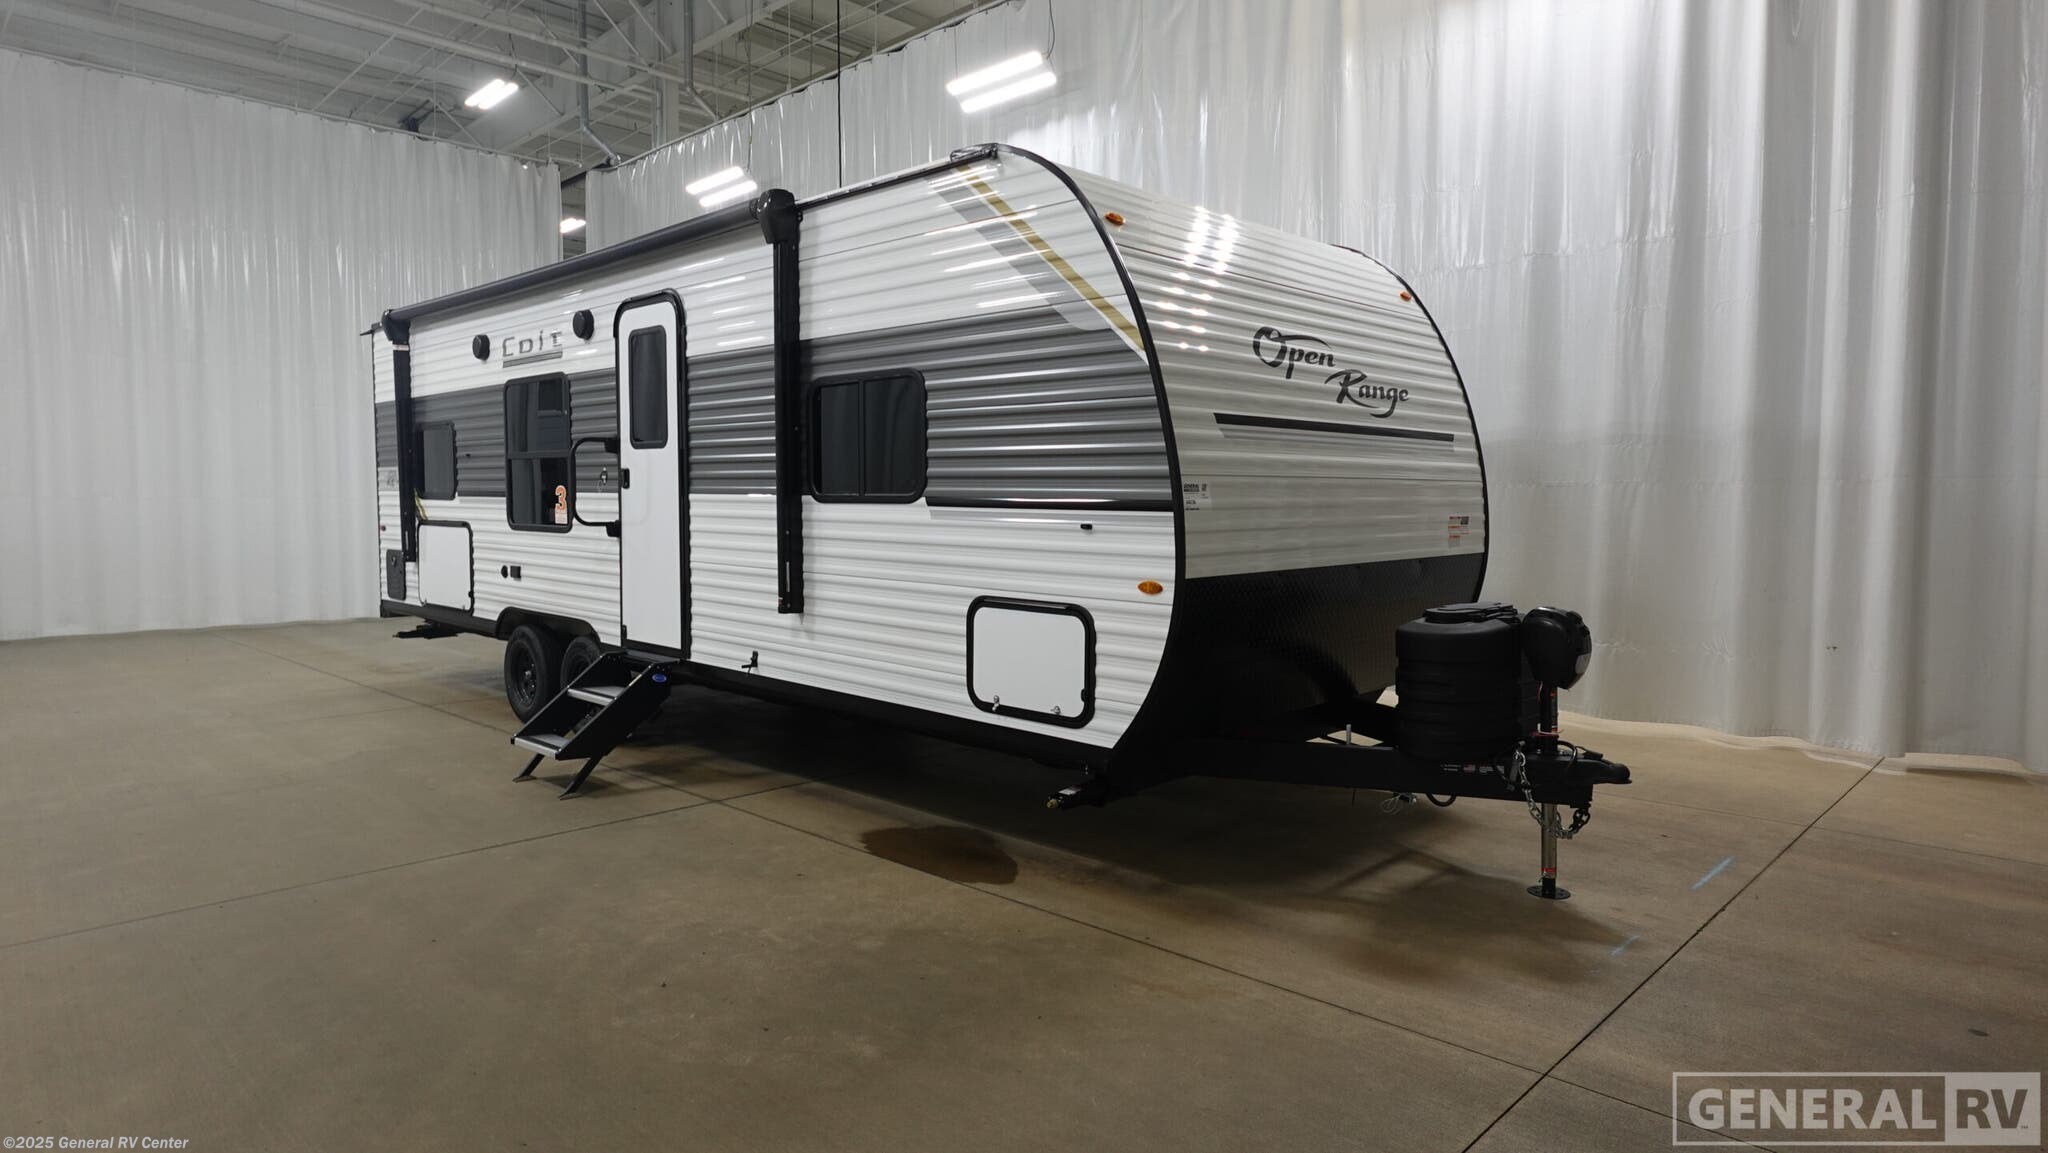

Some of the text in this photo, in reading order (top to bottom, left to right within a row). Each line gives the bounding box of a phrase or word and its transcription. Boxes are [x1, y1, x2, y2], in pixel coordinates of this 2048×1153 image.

[1253, 326, 1336, 380] Open
[1324, 368, 1409, 418] Range
[555, 486, 567, 510] 3
